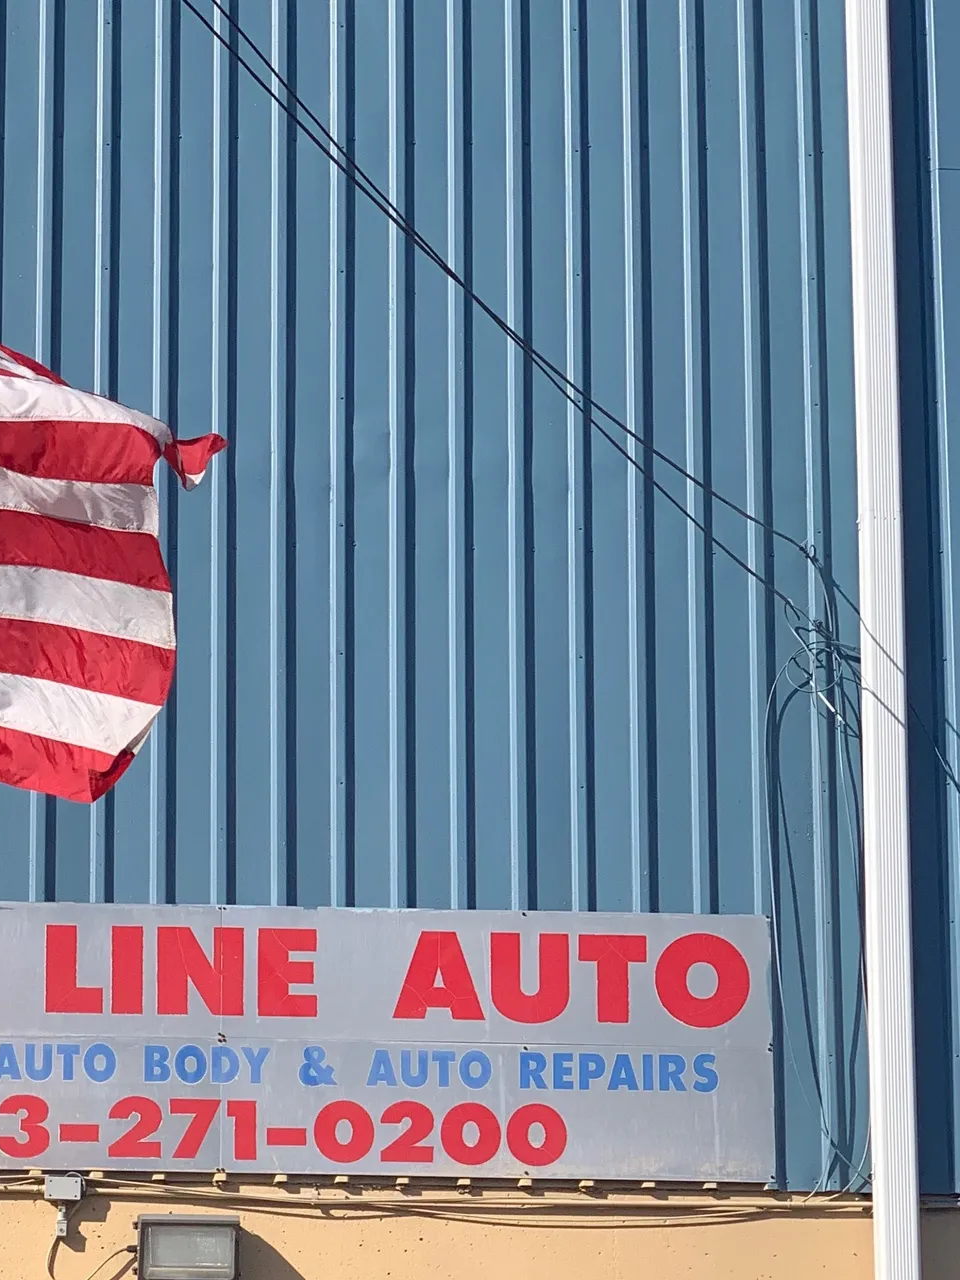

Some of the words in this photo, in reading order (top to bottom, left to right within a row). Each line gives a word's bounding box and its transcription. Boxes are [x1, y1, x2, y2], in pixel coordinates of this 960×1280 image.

[45, 924, 318, 1017] LINE
[392, 930, 751, 1029] AUTO
[144, 1044, 270, 1085] BODY
[298, 1045, 337, 1087] &
[366, 1049, 492, 1090] AUTO
[519, 1051, 719, 1093] REPAIRS
